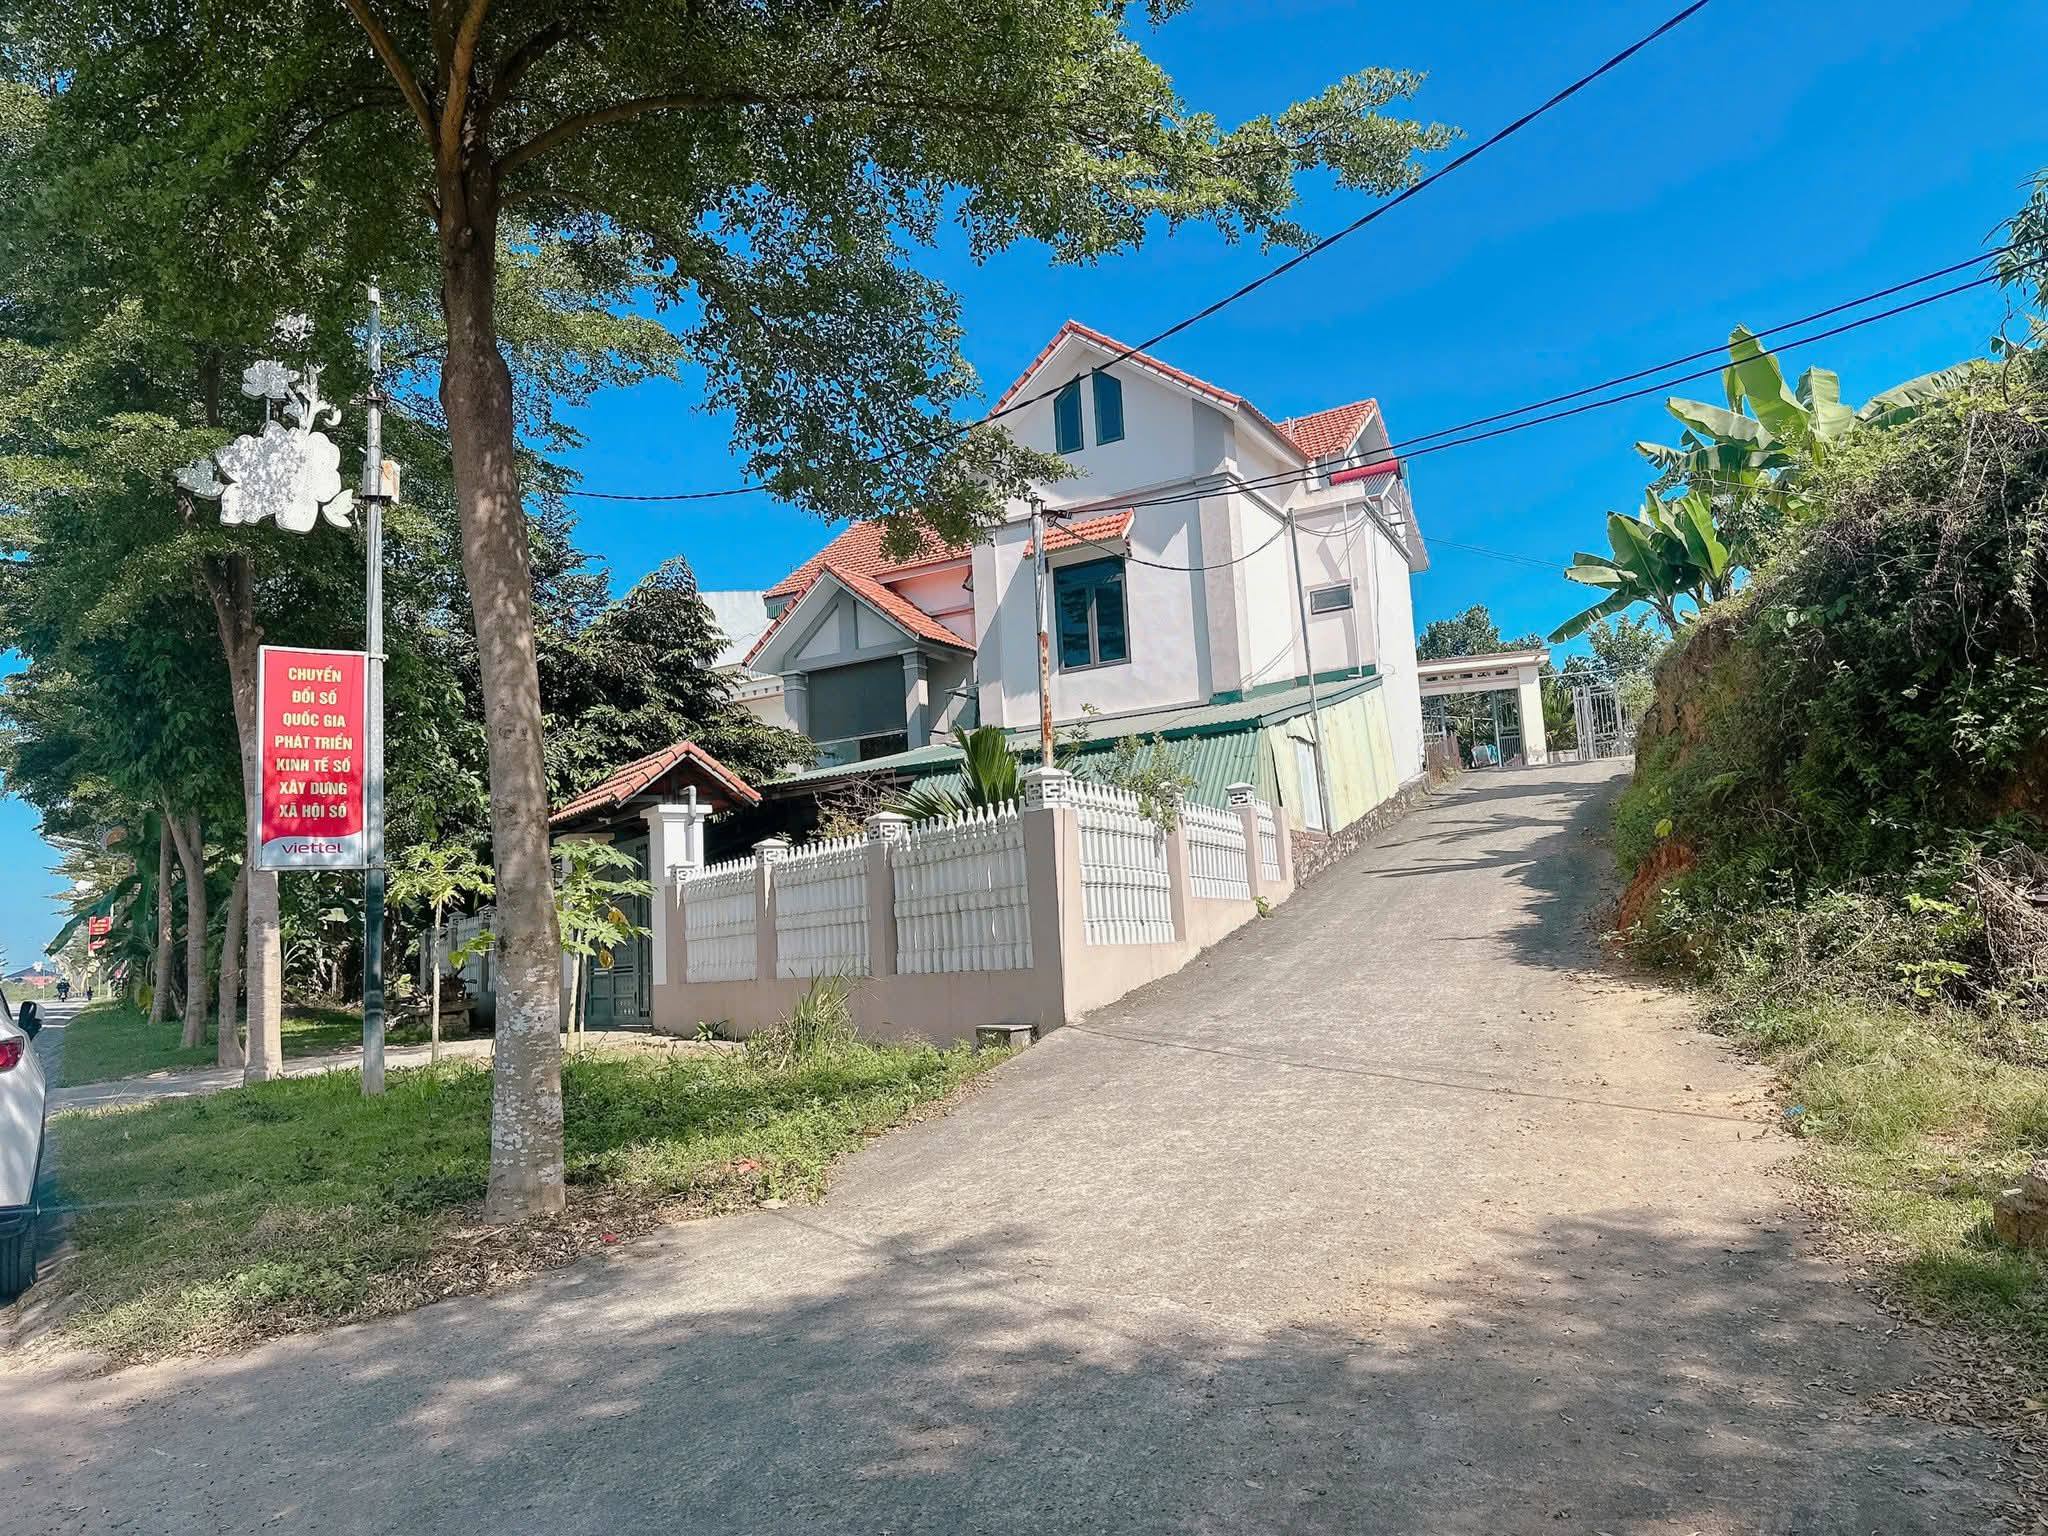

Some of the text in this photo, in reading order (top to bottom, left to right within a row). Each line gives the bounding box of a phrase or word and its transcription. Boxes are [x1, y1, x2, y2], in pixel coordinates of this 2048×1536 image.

[292, 686, 338, 705] ĐỔI SỐ
[282, 709, 346, 728] QUỐC GIA
[274, 732, 353, 750] PHÁT TRIỂN
[276, 755, 351, 773] KINH TẾ SỐ
[279, 779, 348, 797] XÂY DỰNG
[279, 801, 347, 820] XÃ HỘI SỐ
[281, 842, 344, 854] viettel
